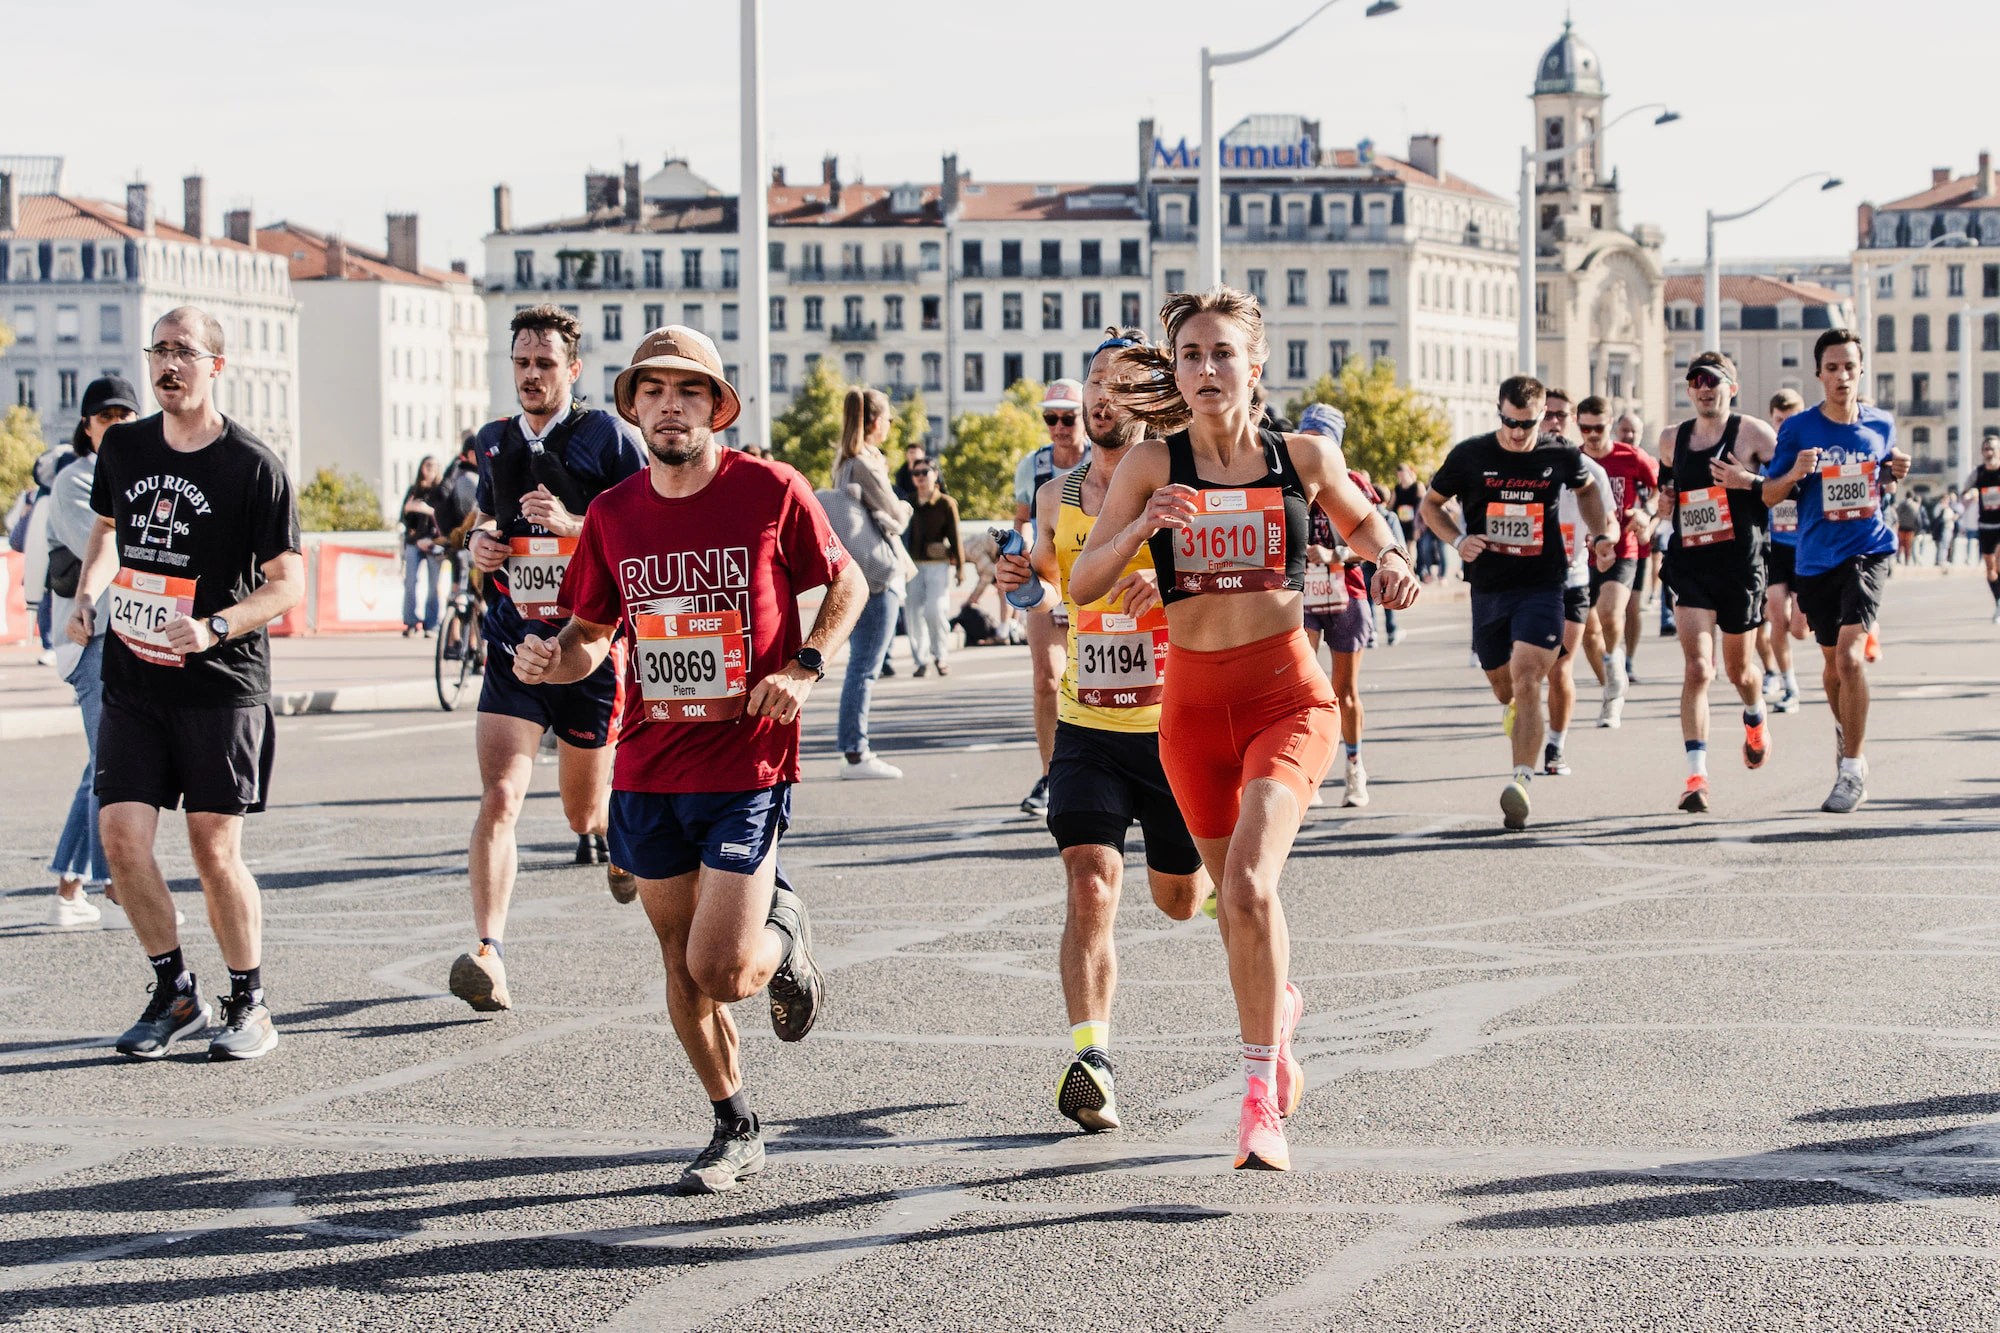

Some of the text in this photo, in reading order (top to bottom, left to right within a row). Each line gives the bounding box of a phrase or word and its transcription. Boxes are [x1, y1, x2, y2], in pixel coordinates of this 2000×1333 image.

[125, 474, 212, 515] LOU RUGBY
[1501, 490, 1520, 500] TEAM
[1827, 481, 1866, 501] 32880
[130, 514, 147, 528] 18
[1682, 506, 1717, 527] 30808
[173, 521, 190, 535] 96
[1491, 520, 1529, 538] 31123
[1181, 524, 1257, 559] 31610
[1267, 522, 1281, 555] PREF
[1208, 560, 1233, 571] Emma
[619, 549, 722, 600] RUN
[1216, 576, 1243, 589] 10K
[1303, 581, 1333, 596] 7608
[114, 595, 168, 630] 24716
[538, 606, 559, 616] 10K
[688, 618, 723, 632] PREF
[725, 659, 742, 668] min
[1084, 642, 1147, 675] 31194
[645, 650, 717, 684] 30869
[673, 684, 697, 696] Pierre
[1113, 692, 1138, 705] 10K
[682, 704, 707, 717] 10K
